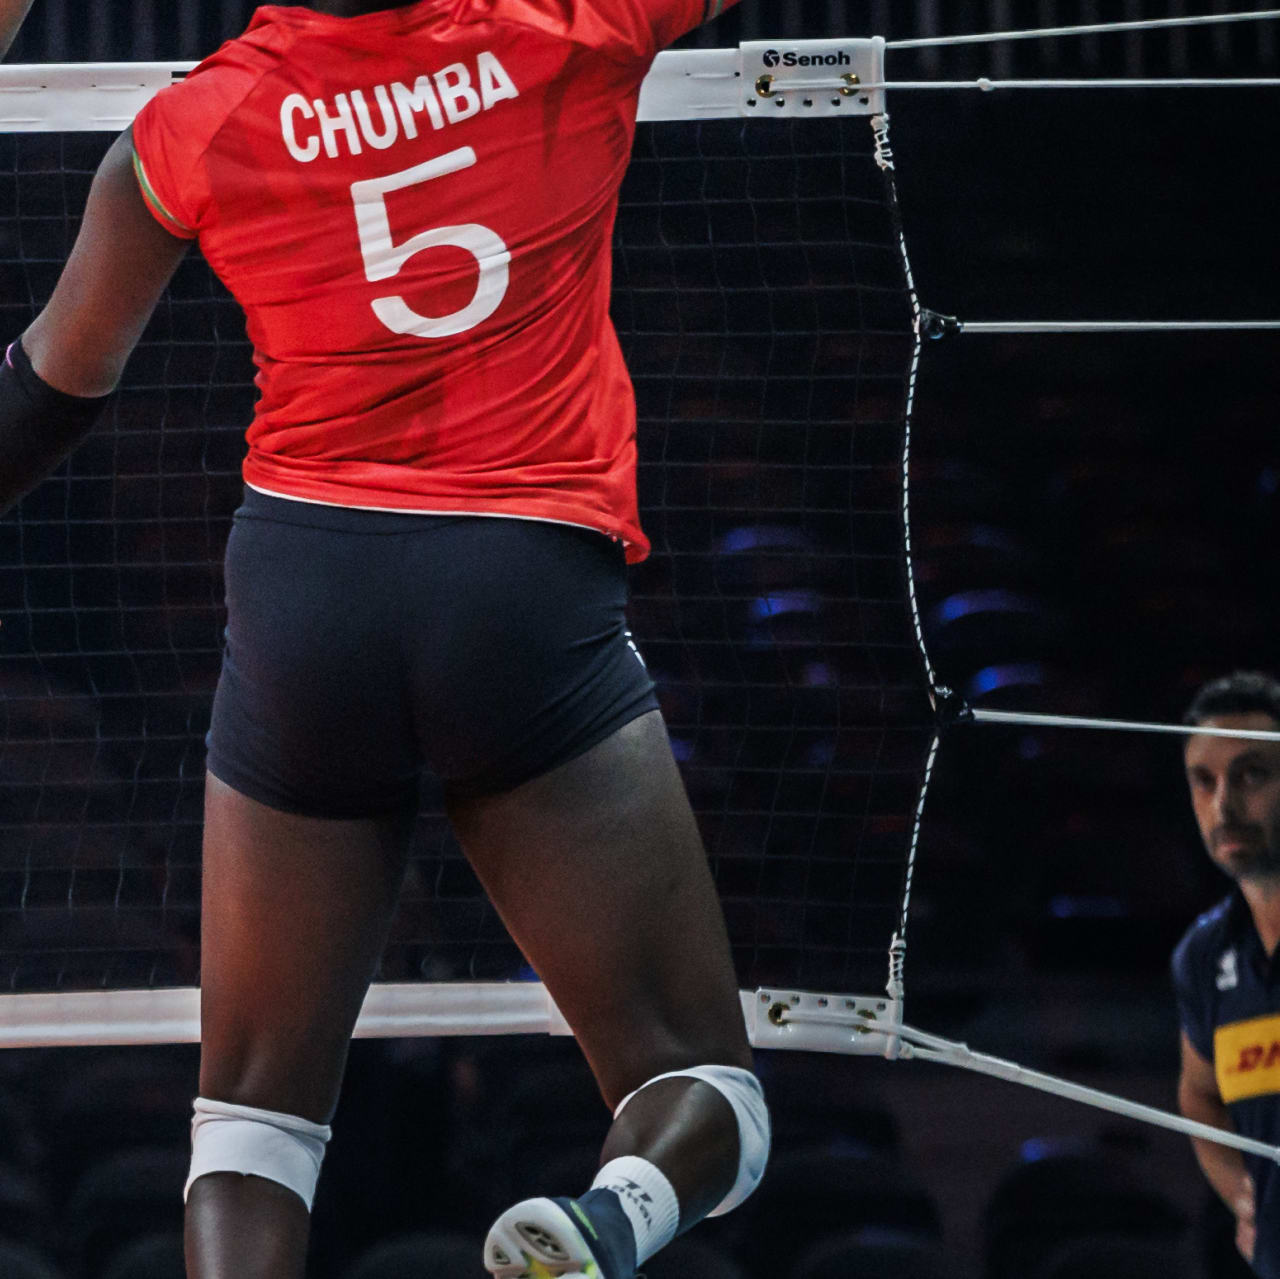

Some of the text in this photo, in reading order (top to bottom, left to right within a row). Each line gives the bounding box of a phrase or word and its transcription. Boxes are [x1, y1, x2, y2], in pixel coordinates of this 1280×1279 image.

[280, 51, 519, 162] CHUMBA
[782, 51, 851, 67] Senoh
[350, 146, 511, 338] 5
